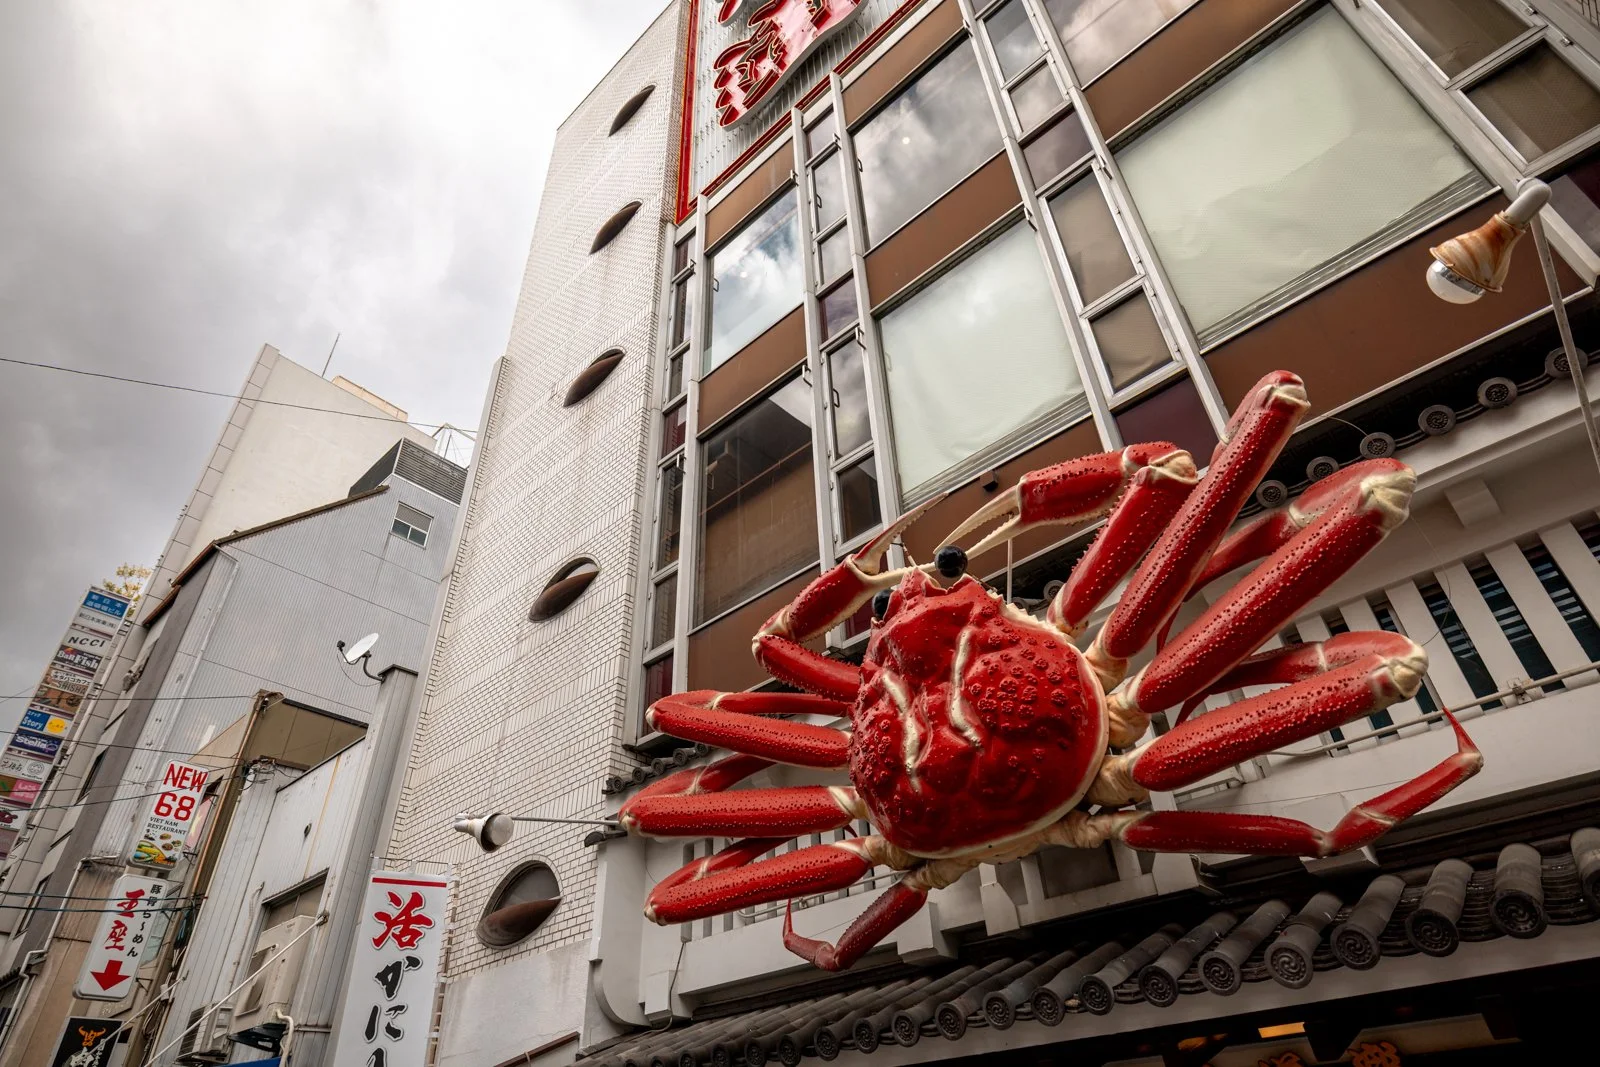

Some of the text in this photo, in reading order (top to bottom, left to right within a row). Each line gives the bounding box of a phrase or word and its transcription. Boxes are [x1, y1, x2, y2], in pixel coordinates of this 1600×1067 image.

[68, 636, 105, 647] NCCI
[22, 716, 43, 730] Story
[16, 736, 47, 749] Stella
[163, 763, 209, 793] NEW
[154, 791, 196, 821] 68
[150, 816, 164, 824] VIET
[147, 823, 187, 835] RESTAURANT
